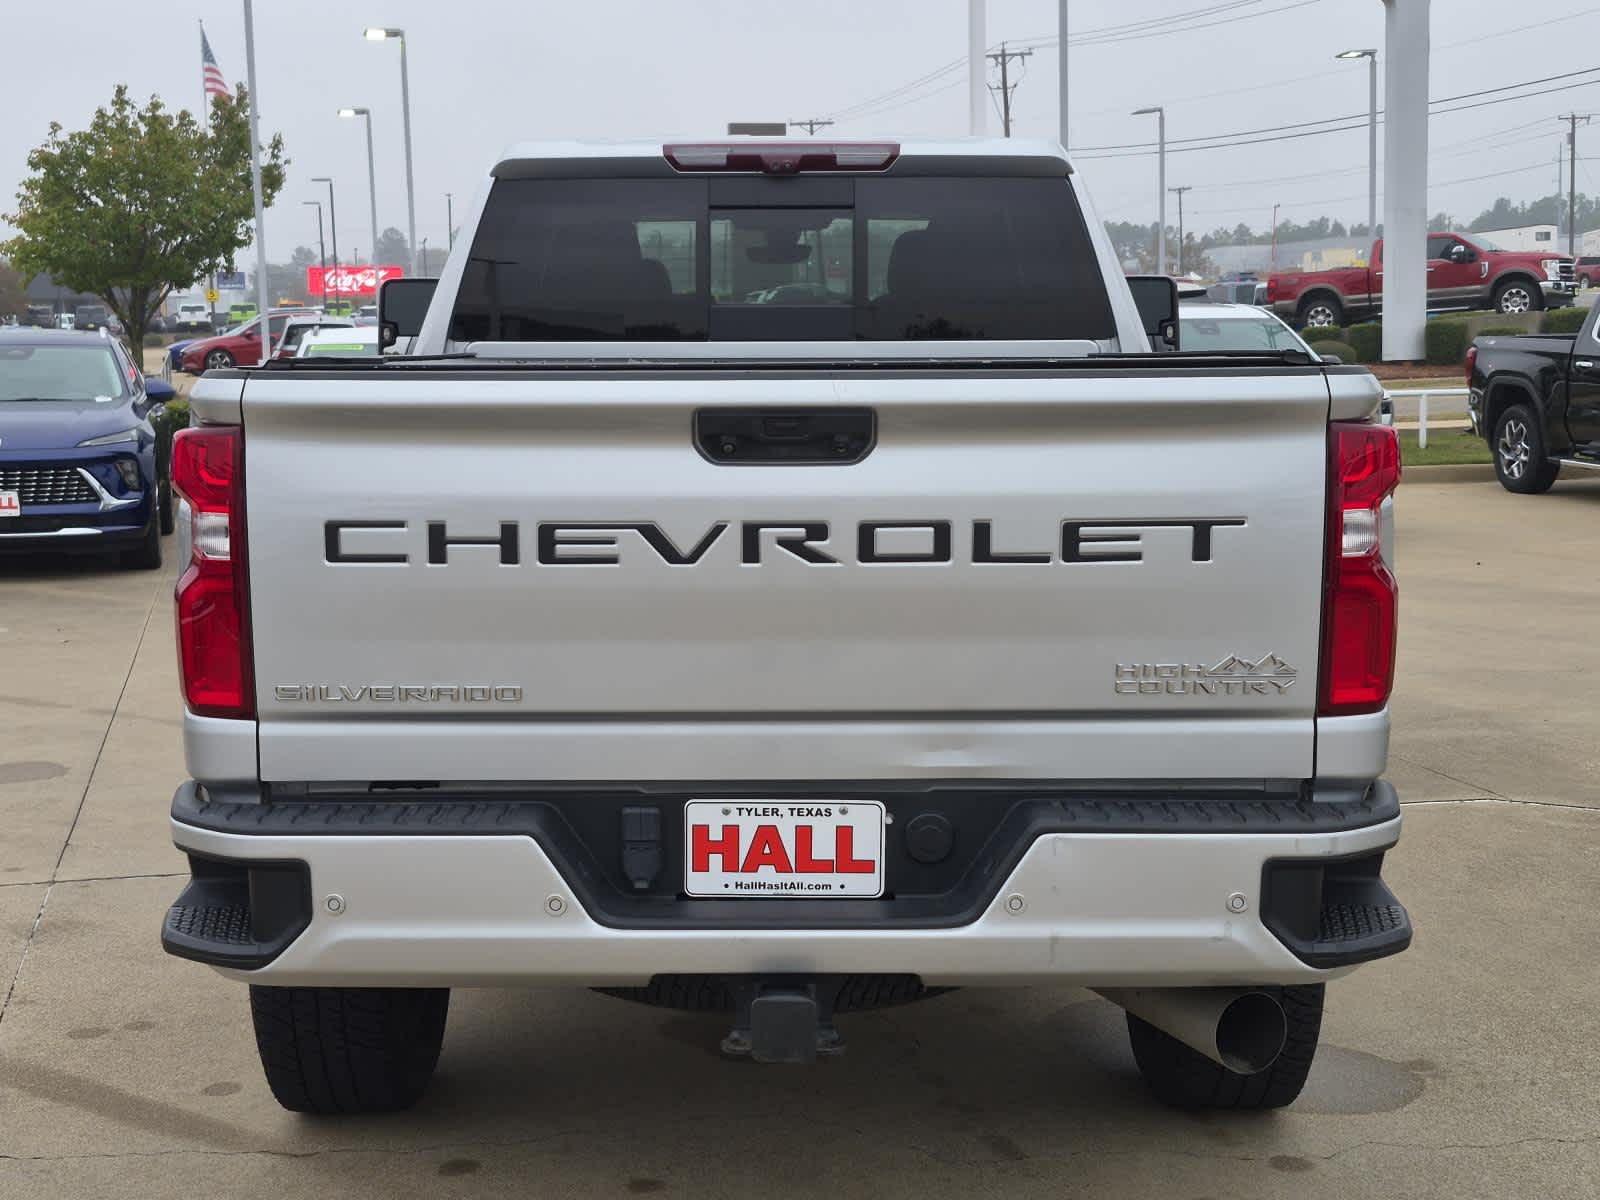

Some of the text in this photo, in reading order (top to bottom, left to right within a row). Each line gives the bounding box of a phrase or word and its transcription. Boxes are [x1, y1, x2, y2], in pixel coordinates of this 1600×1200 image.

[324, 516, 1247, 567] CHEVROLET
[1115, 664, 1208, 678] HIGH
[274, 684, 523, 702] SILVERADO
[1115, 680, 1296, 695] COUNTRY
[736, 807, 832, 819] TYLER, TEXAS
[691, 824, 876, 874] HALL
[734, 881, 832, 891] HallHasItAll.com
